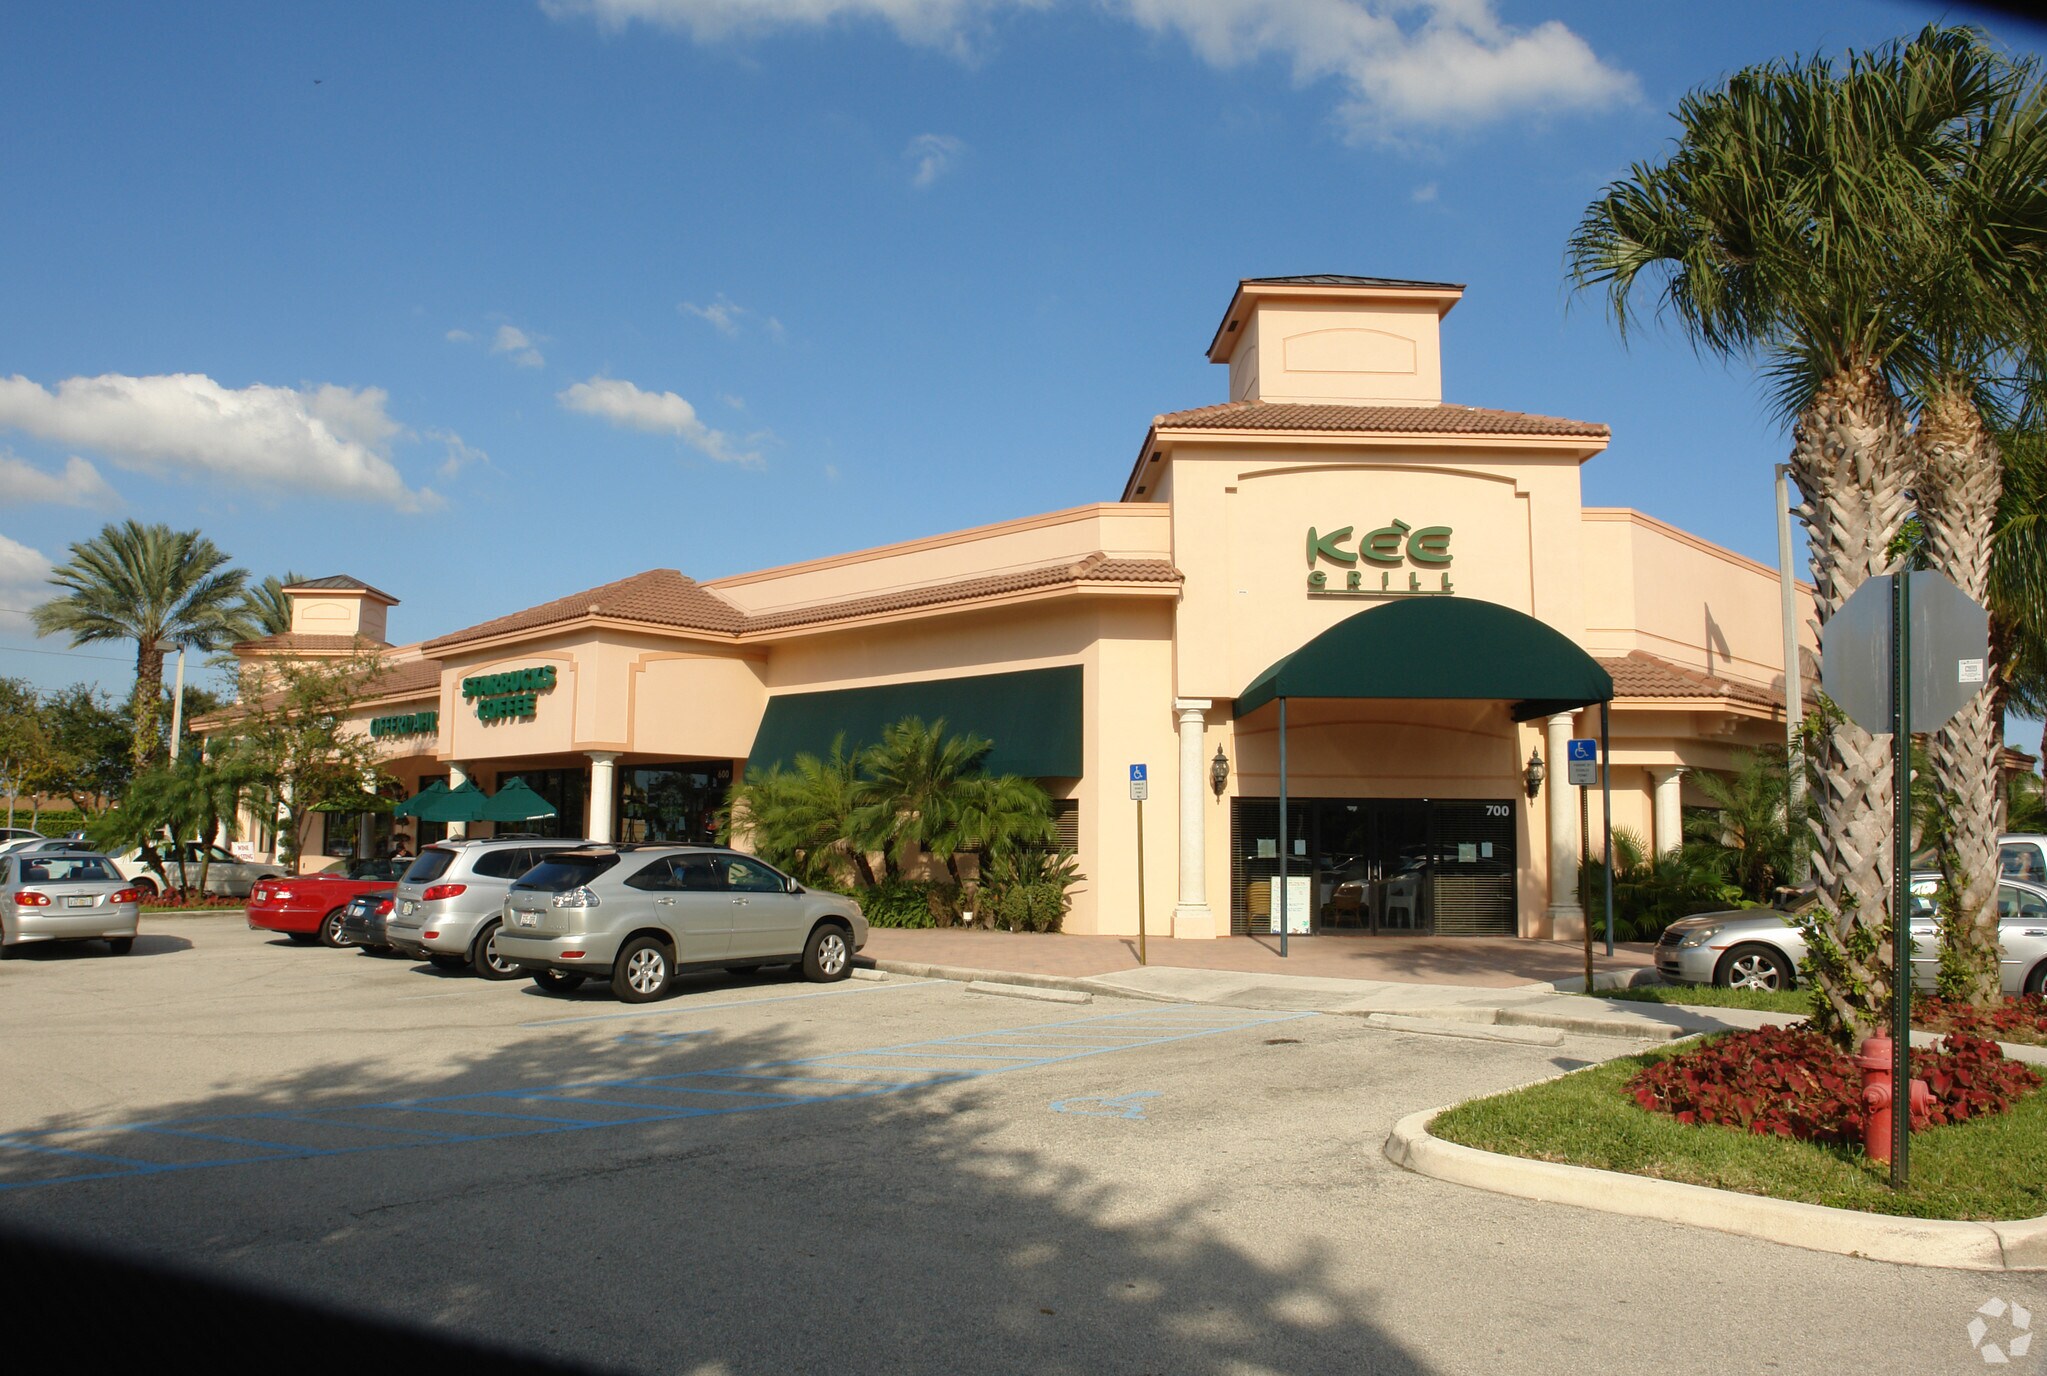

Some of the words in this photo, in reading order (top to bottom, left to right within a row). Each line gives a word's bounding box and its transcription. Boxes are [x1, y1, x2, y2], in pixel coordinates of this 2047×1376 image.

[1307, 570, 1454, 589] GRILL
[462, 665, 557, 698] STARBUCKS
[478, 693, 537, 721] COFFEE
[1485, 805, 1510, 817] 700
